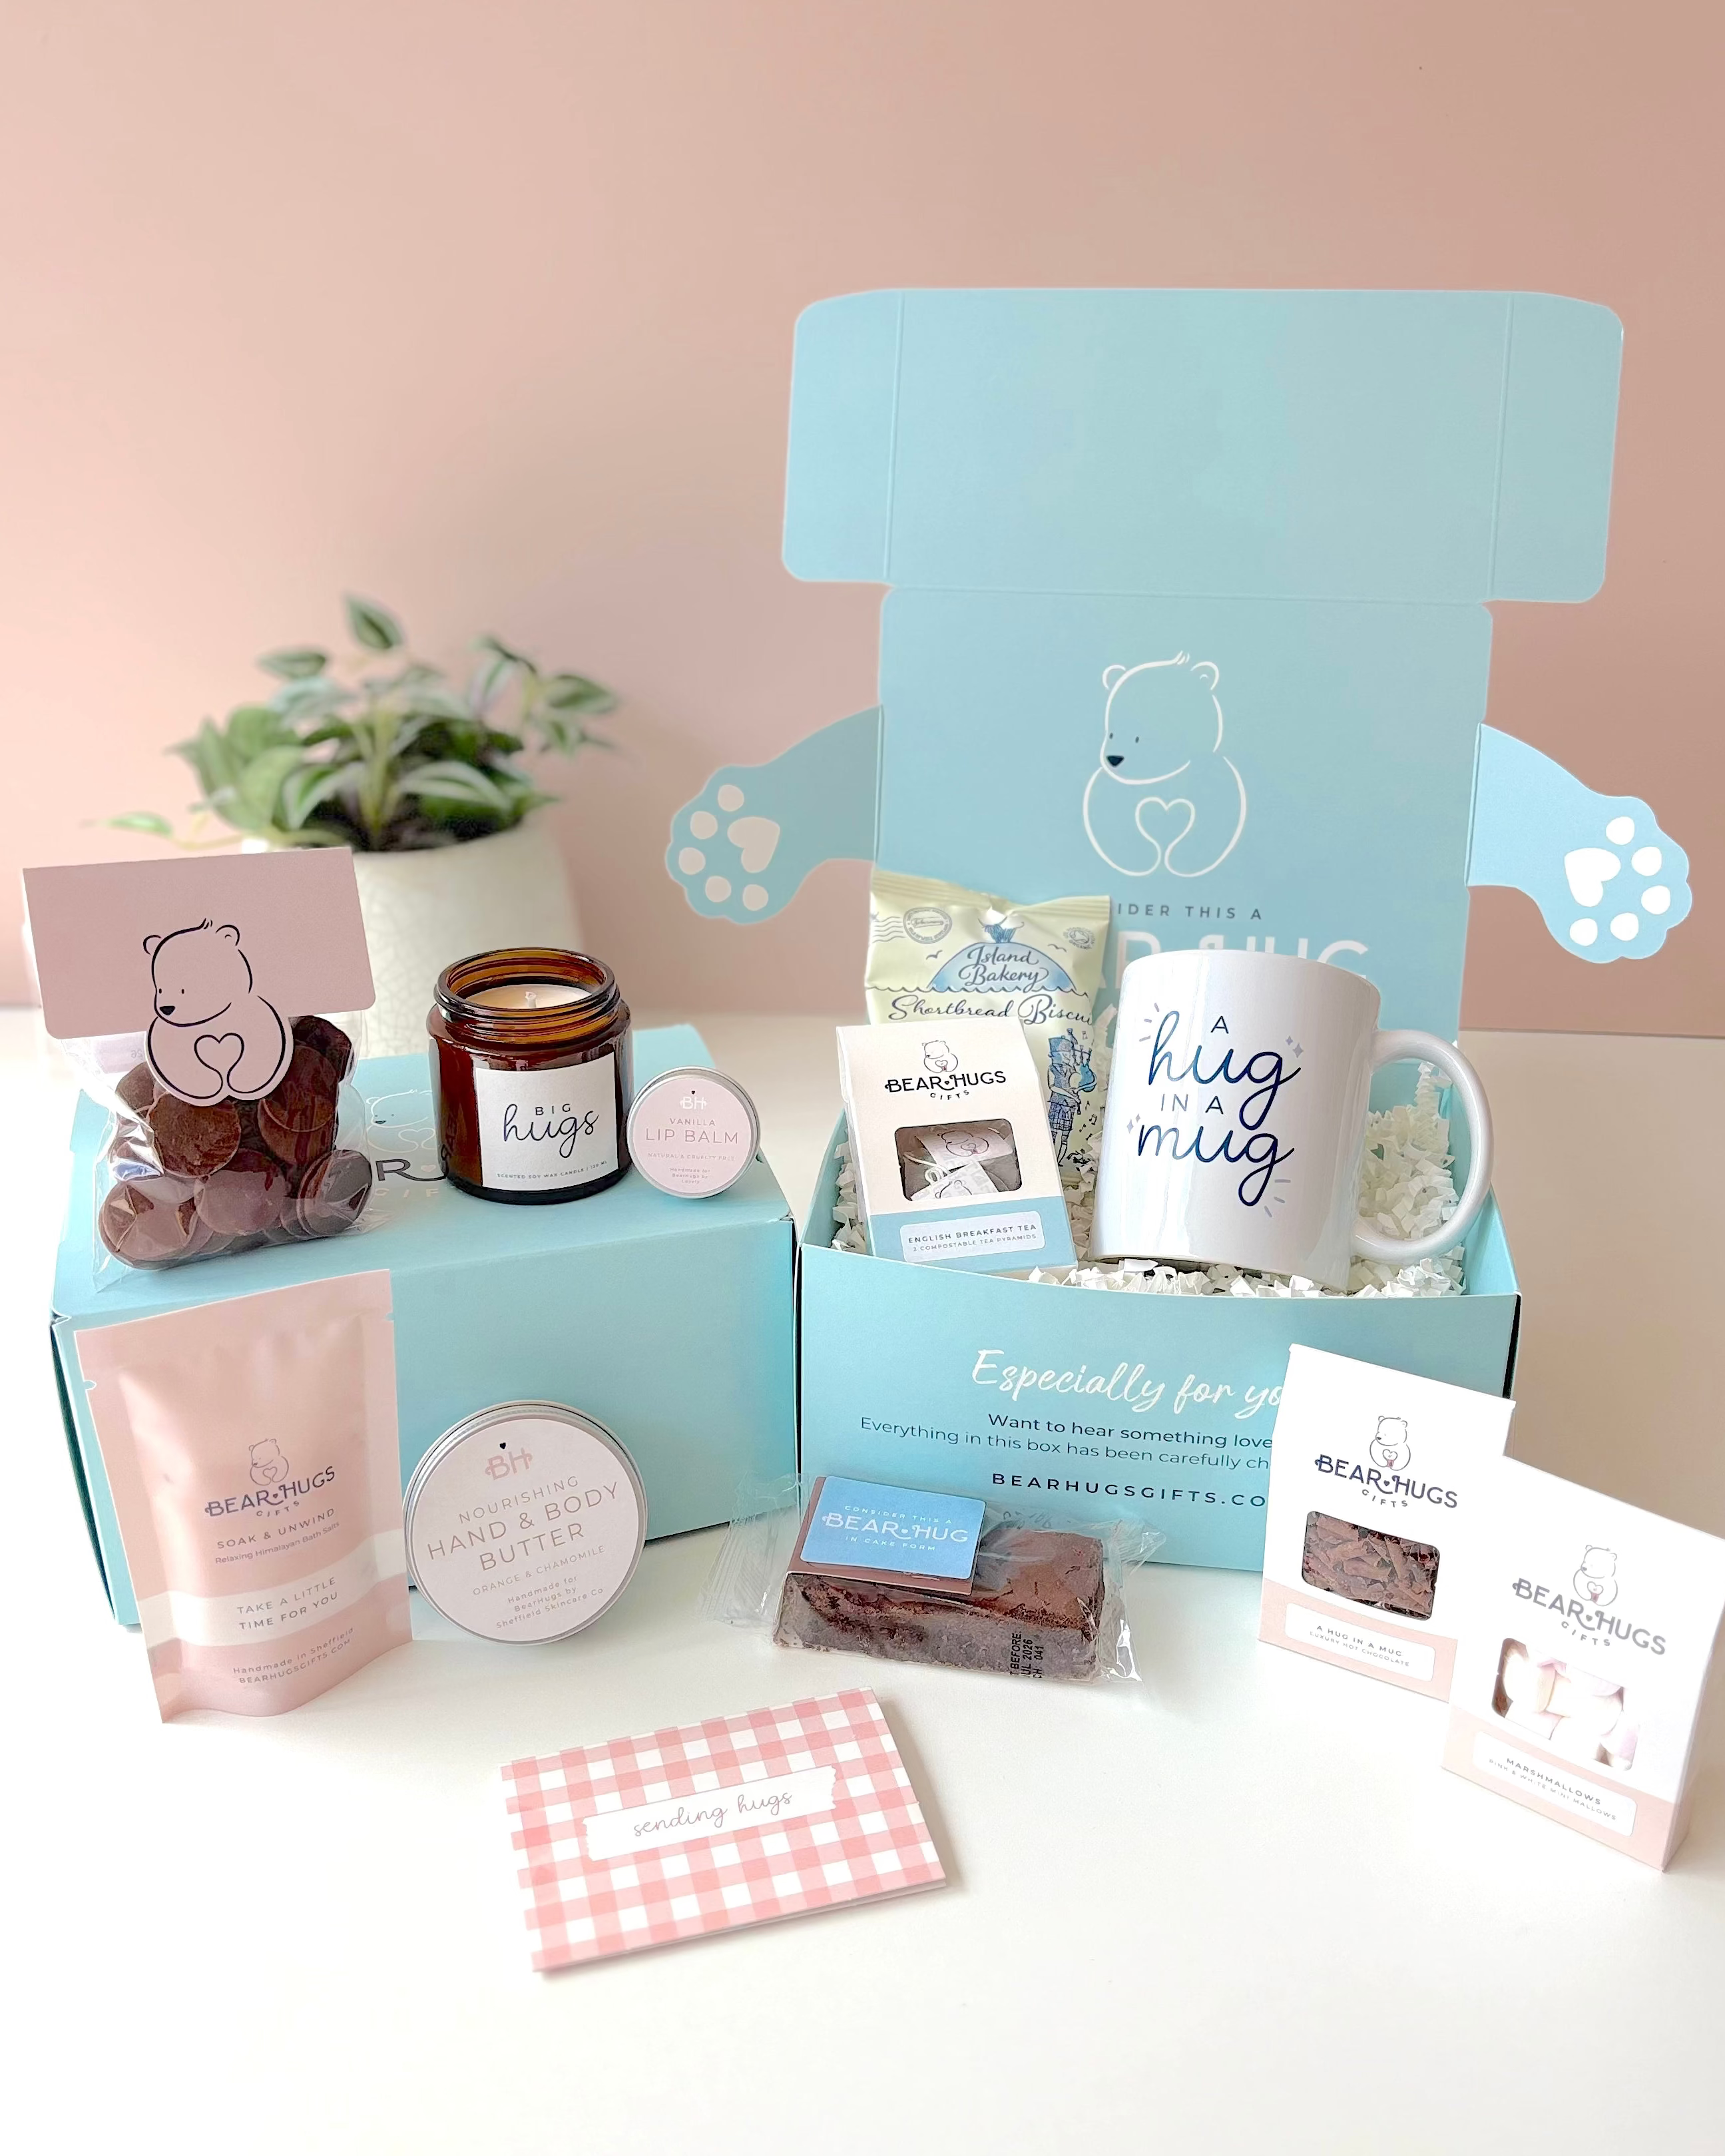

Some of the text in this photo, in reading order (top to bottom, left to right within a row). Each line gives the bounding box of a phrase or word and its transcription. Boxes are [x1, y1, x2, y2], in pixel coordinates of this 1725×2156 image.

[1118, 903, 1262, 920] IDER THIS A
[967, 946, 1039, 966] Island
[959, 964, 1049, 993] Bakery
[888, 993, 1093, 1025] Shortbread Biscui
[1210, 1015, 1229, 1034] A
[885, 1071, 1007, 1093] BEAR HUGS
[1148, 1010, 1301, 1131] hug
[535, 1103, 571, 1116] BIG
[680, 1096, 707, 1110] BH
[930, 1090, 969, 1101] GIFTS
[1160, 1093, 1224, 1115] IN A
[504, 1103, 599, 1159] hugs
[646, 1128, 738, 1144] LIP BALM
[669, 1117, 716, 1126] VANILLA
[560, 1168, 585, 1177] CANDLE
[1138, 1125, 1295, 1207] mug
[374, 1187, 439, 1199] GIF
[908, 1233, 951, 1244] ENGLISH
[956, 1226, 1013, 1238] BREAKFAST
[919, 1240, 977, 1251] COMPOSTABLE
[997, 1234, 1037, 1243] PYRAMIDS
[971, 1349, 1280, 1420] Especially for yo
[861, 1418, 959, 1445] Everything
[965, 1431, 982, 1446] in
[987, 1434, 1023, 1450] this
[1027, 1437, 1061, 1454] box
[1067, 1442, 1100, 1458] has
[1105, 1444, 1152, 1462] been
[1158, 1450, 1241, 1470] carefully
[988, 1414, 1272, 1450] Want to hear something love
[484, 1447, 533, 1481] BH
[205, 1466, 336, 1517] BEAR HUGS
[992, 1473, 1266, 1508] BEARHUGSGIFTS.CO
[1315, 1454, 1458, 1509] BEAR HUGS
[1361, 1489, 1408, 1507] GIFTS
[256, 1501, 300, 1517] GIFTS
[458, 1476, 579, 1524] NOURISHING
[844, 1505, 906, 1519] CONSIDER
[913, 1515, 939, 1523] THIS
[217, 1508, 336, 1549] SOAK & UNWIND
[427, 1481, 618, 1560] HAND & BODY
[822, 1512, 969, 1543] BEAR HUG
[215, 1521, 340, 1565] Relaxing Himalayan Bath Salts
[479, 1523, 584, 1571] BUTTER
[864, 1538, 895, 1547] CAKE
[473, 1575, 521, 1595] ORANGE
[536, 1545, 606, 1575] CHAMOMILE
[237, 1601, 274, 1615] TAKE
[294, 1577, 336, 1601] LITTLE
[507, 1575, 578, 1604] Handmade for
[514, 1586, 577, 1612] BearHugs by
[239, 1592, 338, 1631] TIME FOR YOU
[496, 1587, 604, 1629] Sheffield Skincare Co
[1512, 1577, 1666, 1655] BEAR HUGS
[1310, 1631, 1340, 1645] LUXURY
[1361, 1649, 1409, 1667] CHOCOLATE
[1328, 1628, 1348, 1640] HUG
[1379, 1646, 1402, 1657] MUG
[1561, 1621, 1610, 1646] GIFTS
[233, 1658, 293, 1675] Handmade
[310, 1627, 354, 1656] Sheffield
[1021, 1639, 1033, 1675] UL 2026
[1034, 1645, 1044, 1660] 041
[1507, 1758, 1601, 1805] MARSHMALLOWS
[1520, 1774, 1546, 1789] WHITE
[1550, 1787, 1569, 1799] MINI
[1573, 1798, 1616, 1820] MALLOWS
[633, 1792, 792, 1837] sending hugs
